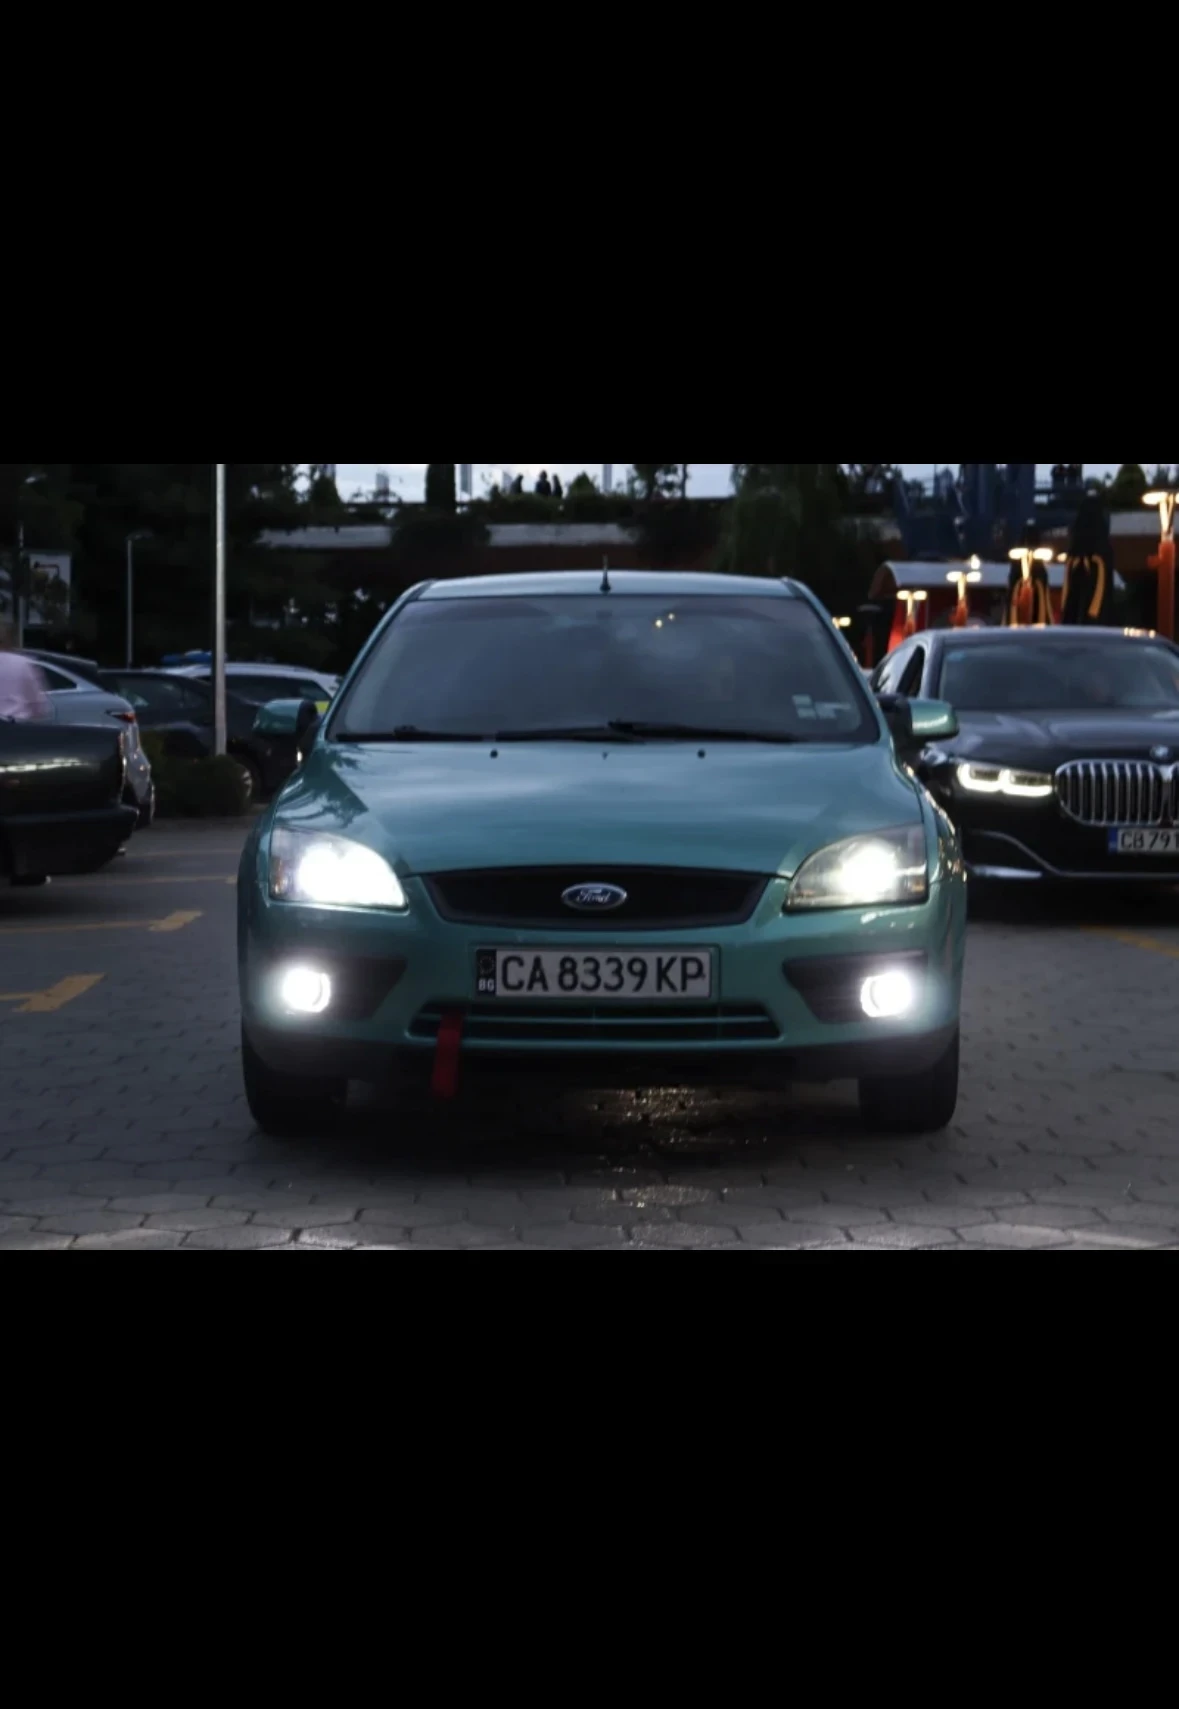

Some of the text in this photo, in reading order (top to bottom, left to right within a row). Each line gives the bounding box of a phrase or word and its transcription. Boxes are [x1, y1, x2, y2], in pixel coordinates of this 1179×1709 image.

[1121, 831, 1144, 848] CB
[576, 888, 611, 904] Ford
[502, 955, 705, 992] CA 8339 KP
[478, 978, 495, 991] BG
